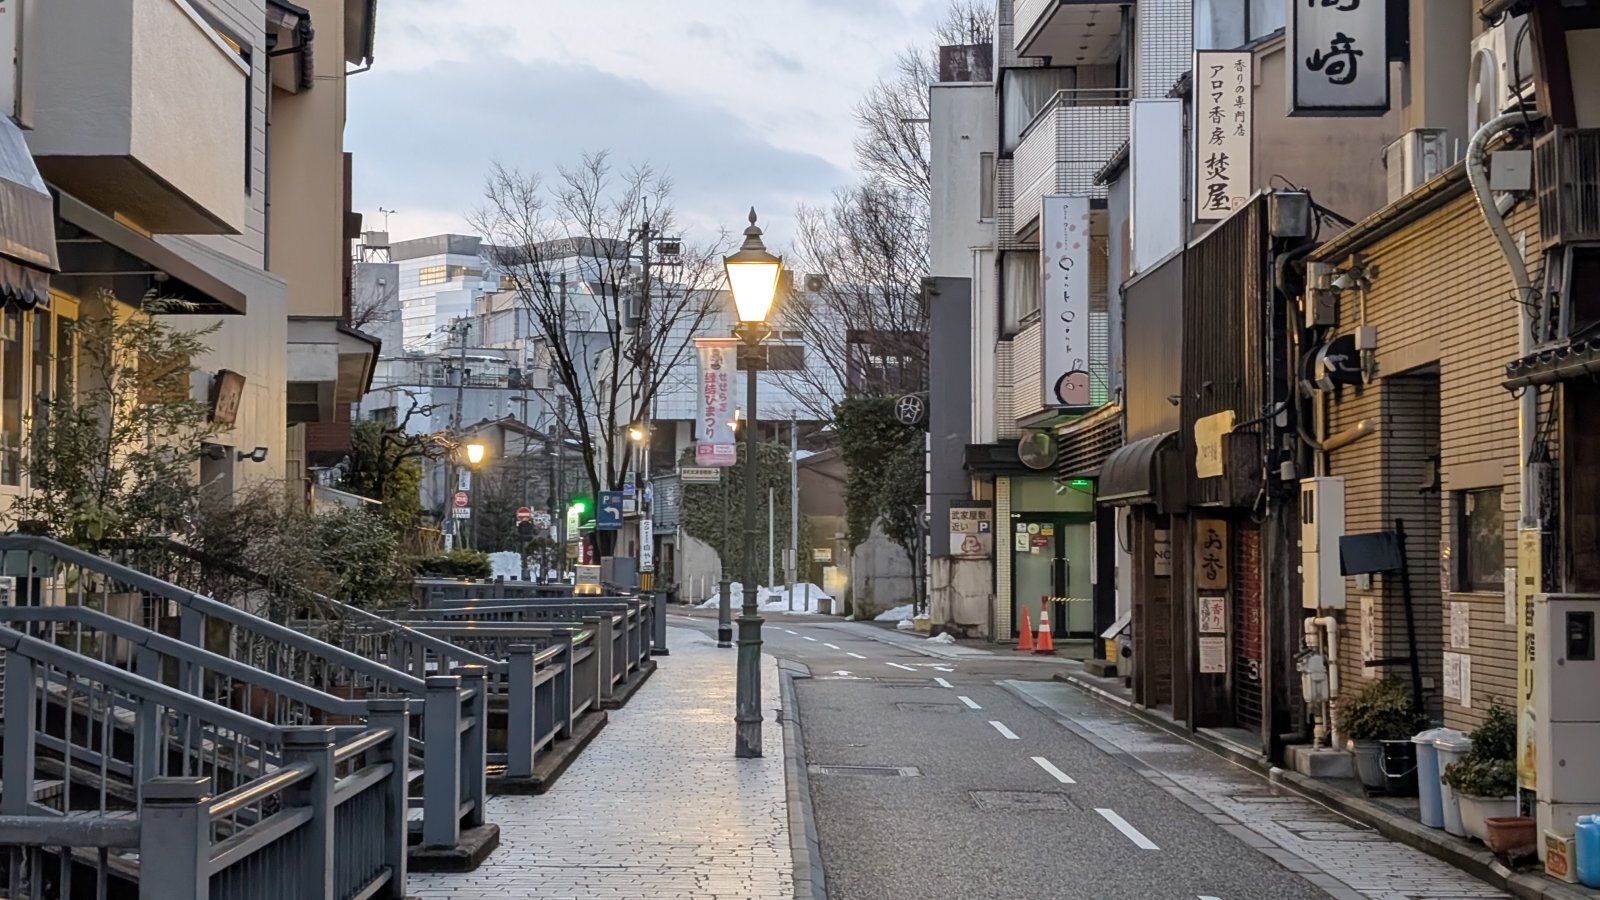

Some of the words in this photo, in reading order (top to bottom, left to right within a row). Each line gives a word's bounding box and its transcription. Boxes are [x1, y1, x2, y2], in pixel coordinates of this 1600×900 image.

[1305, 0, 1363, 85] 崎
[1208, 65, 1226, 146] アロマ香房
[1233, 59, 1246, 137] 香りの専門店
[1202, 152, 1231, 211] 焚屋
[951, 522, 969, 532] 近い
[979, 522, 989, 532] P
[1202, 527, 1224, 581] お香
